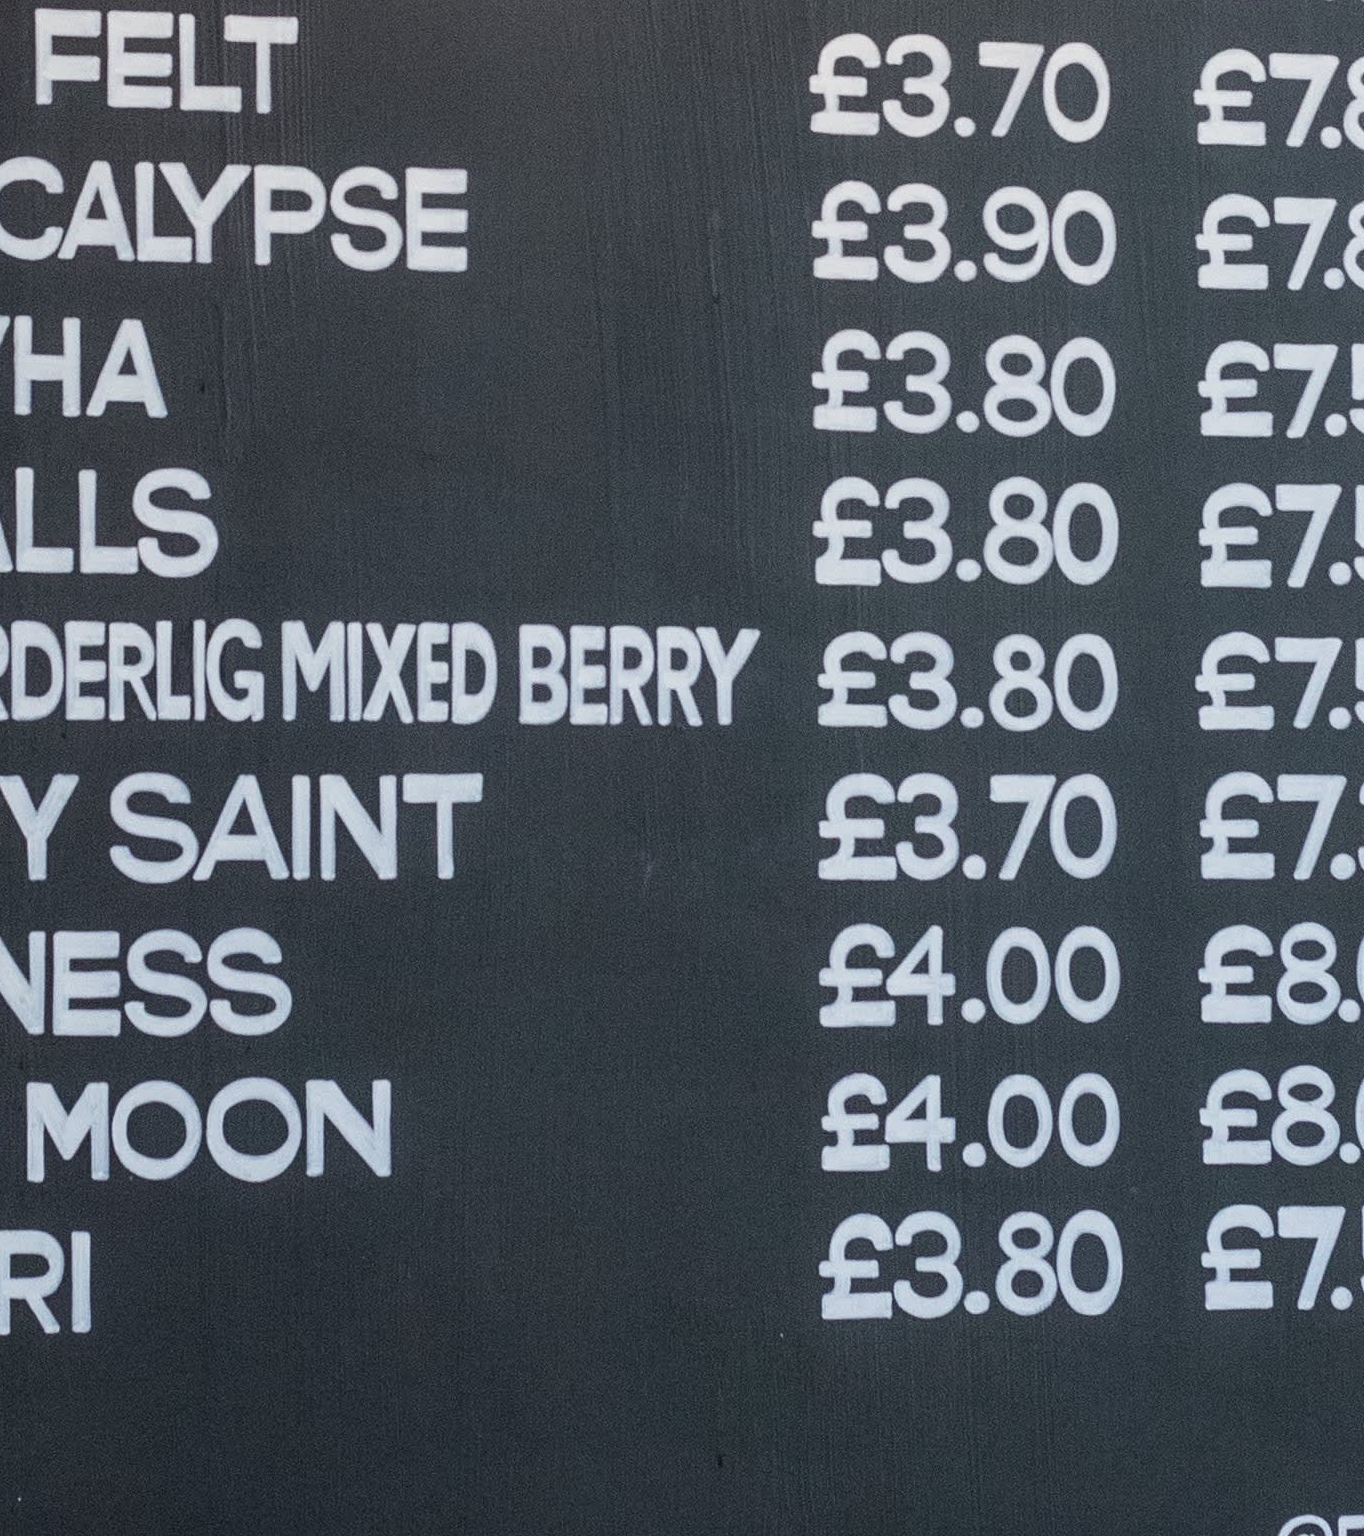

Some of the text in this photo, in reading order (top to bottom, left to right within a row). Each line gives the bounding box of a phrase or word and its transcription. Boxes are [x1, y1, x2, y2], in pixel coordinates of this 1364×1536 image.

[34, 7, 299, 115] FELT
[808, 32, 1111, 143] £3.70
[811, 180, 1117, 286] £3.90
[811, 328, 1117, 438] £3.80
[812, 476, 1119, 587] £3.80
[281, 620, 498, 725] MIXED
[518, 623, 761, 727] BERRY
[817, 630, 1119, 732] £3.80
[109, 772, 484, 884] SAINT
[818, 772, 1118, 881] £3.70
[818, 923, 1121, 1028] £4.00
[26, 1077, 392, 1183] MOON
[821, 1072, 1120, 1172] £4.00
[818, 1209, 1124, 1320] £3.80
